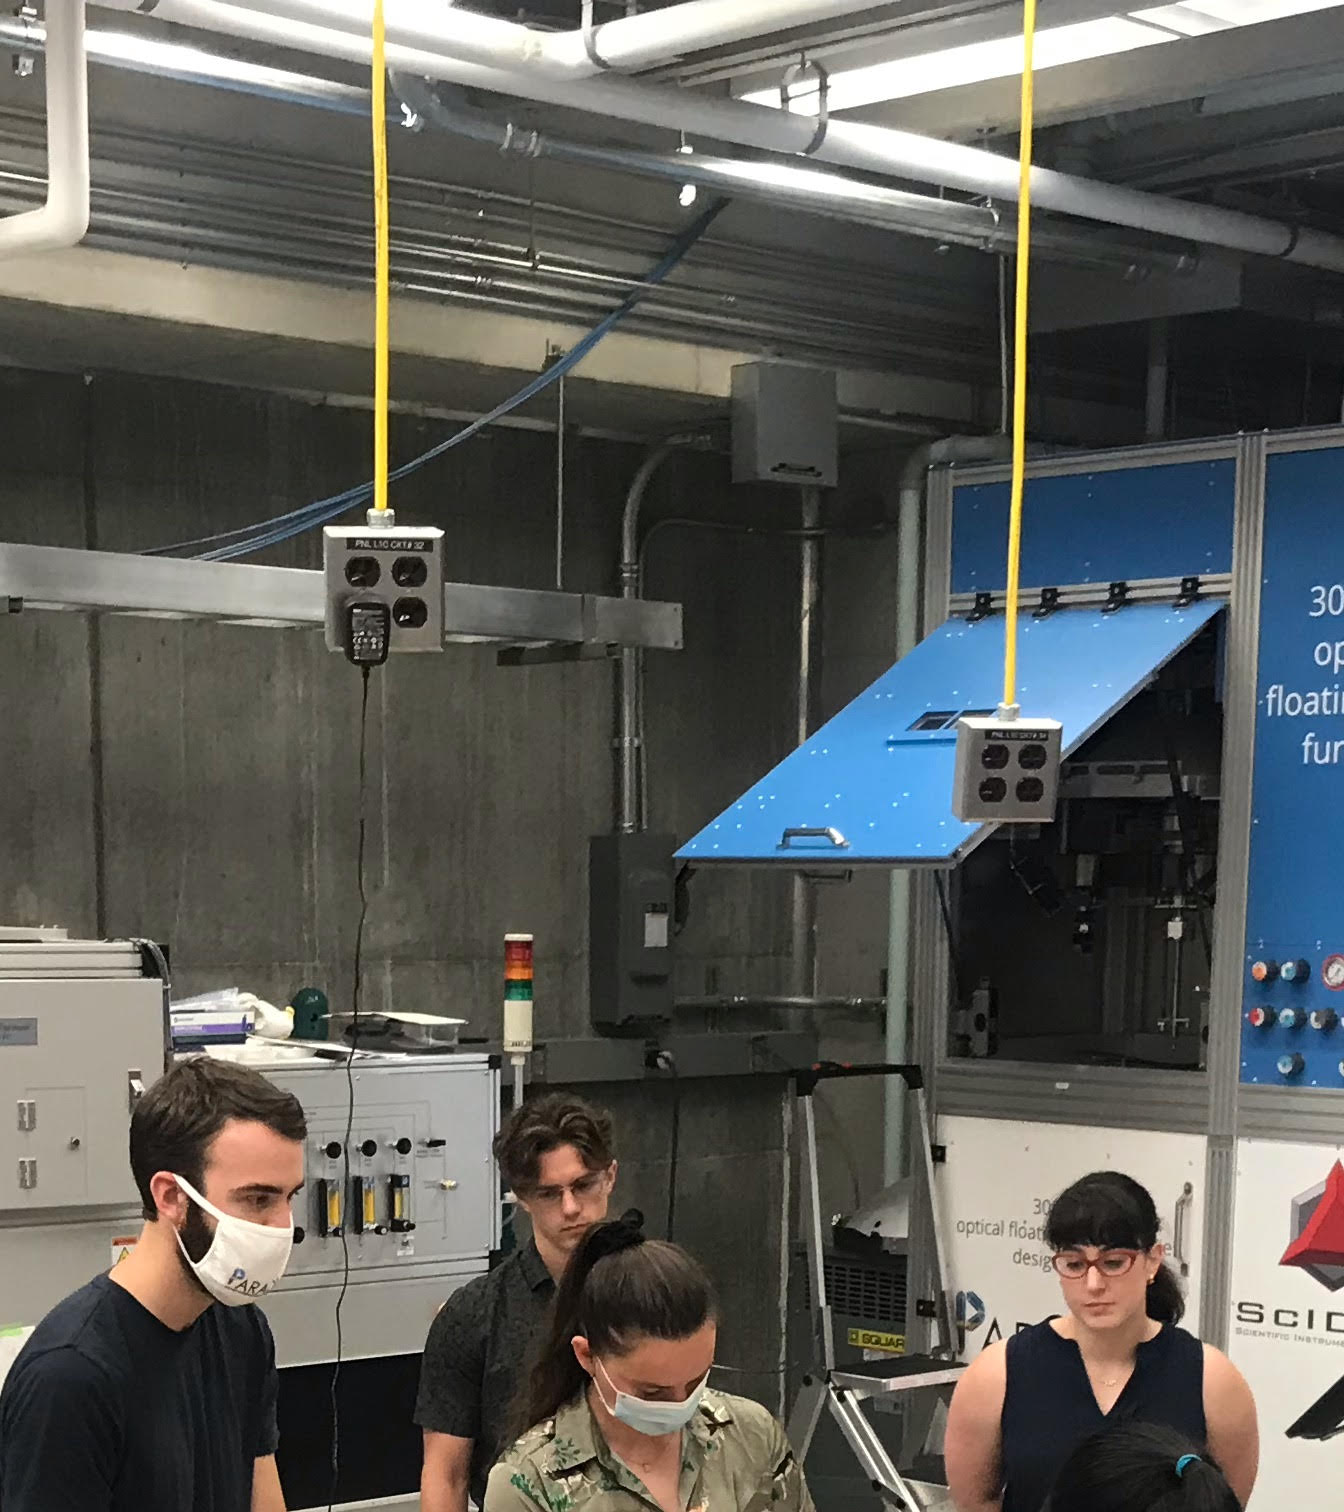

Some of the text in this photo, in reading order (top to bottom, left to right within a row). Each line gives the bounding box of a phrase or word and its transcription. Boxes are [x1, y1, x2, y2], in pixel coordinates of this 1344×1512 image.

[1033, 1198, 1056, 1215] 30
[956, 1219, 1045, 1241] optical float
[1012, 1248, 1052, 1273] desig
[862, 1332, 905, 1348] SQUAR
